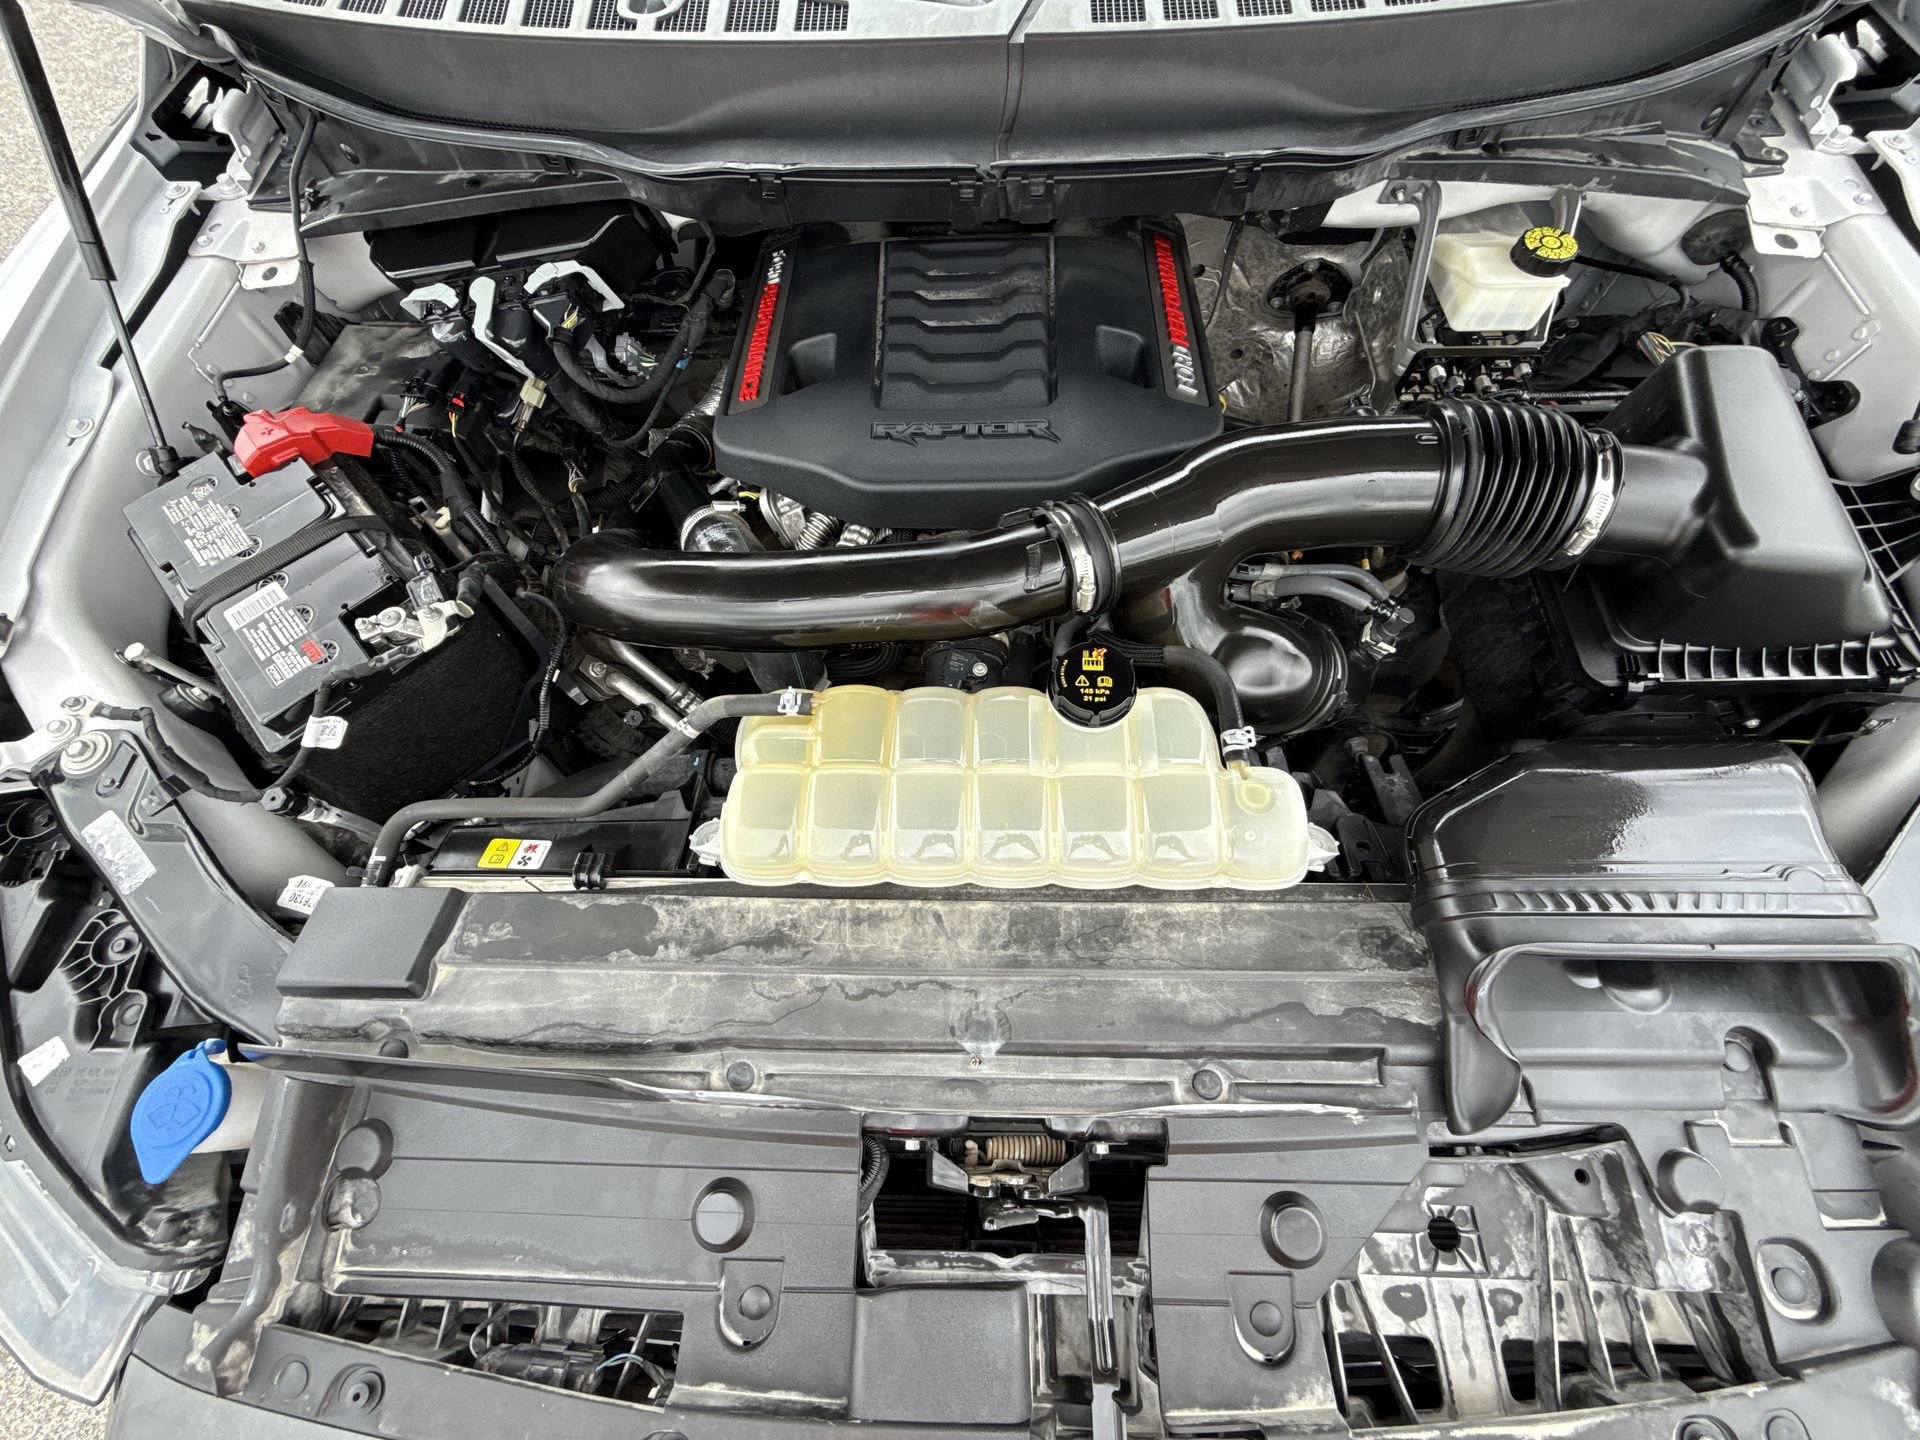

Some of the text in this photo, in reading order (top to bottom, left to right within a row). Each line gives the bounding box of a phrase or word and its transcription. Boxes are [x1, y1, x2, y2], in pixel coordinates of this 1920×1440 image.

[1172, 345, 1199, 397] FORD
[871, 418, 1062, 448] RAPTOR
[1094, 695, 1107, 703] psi
